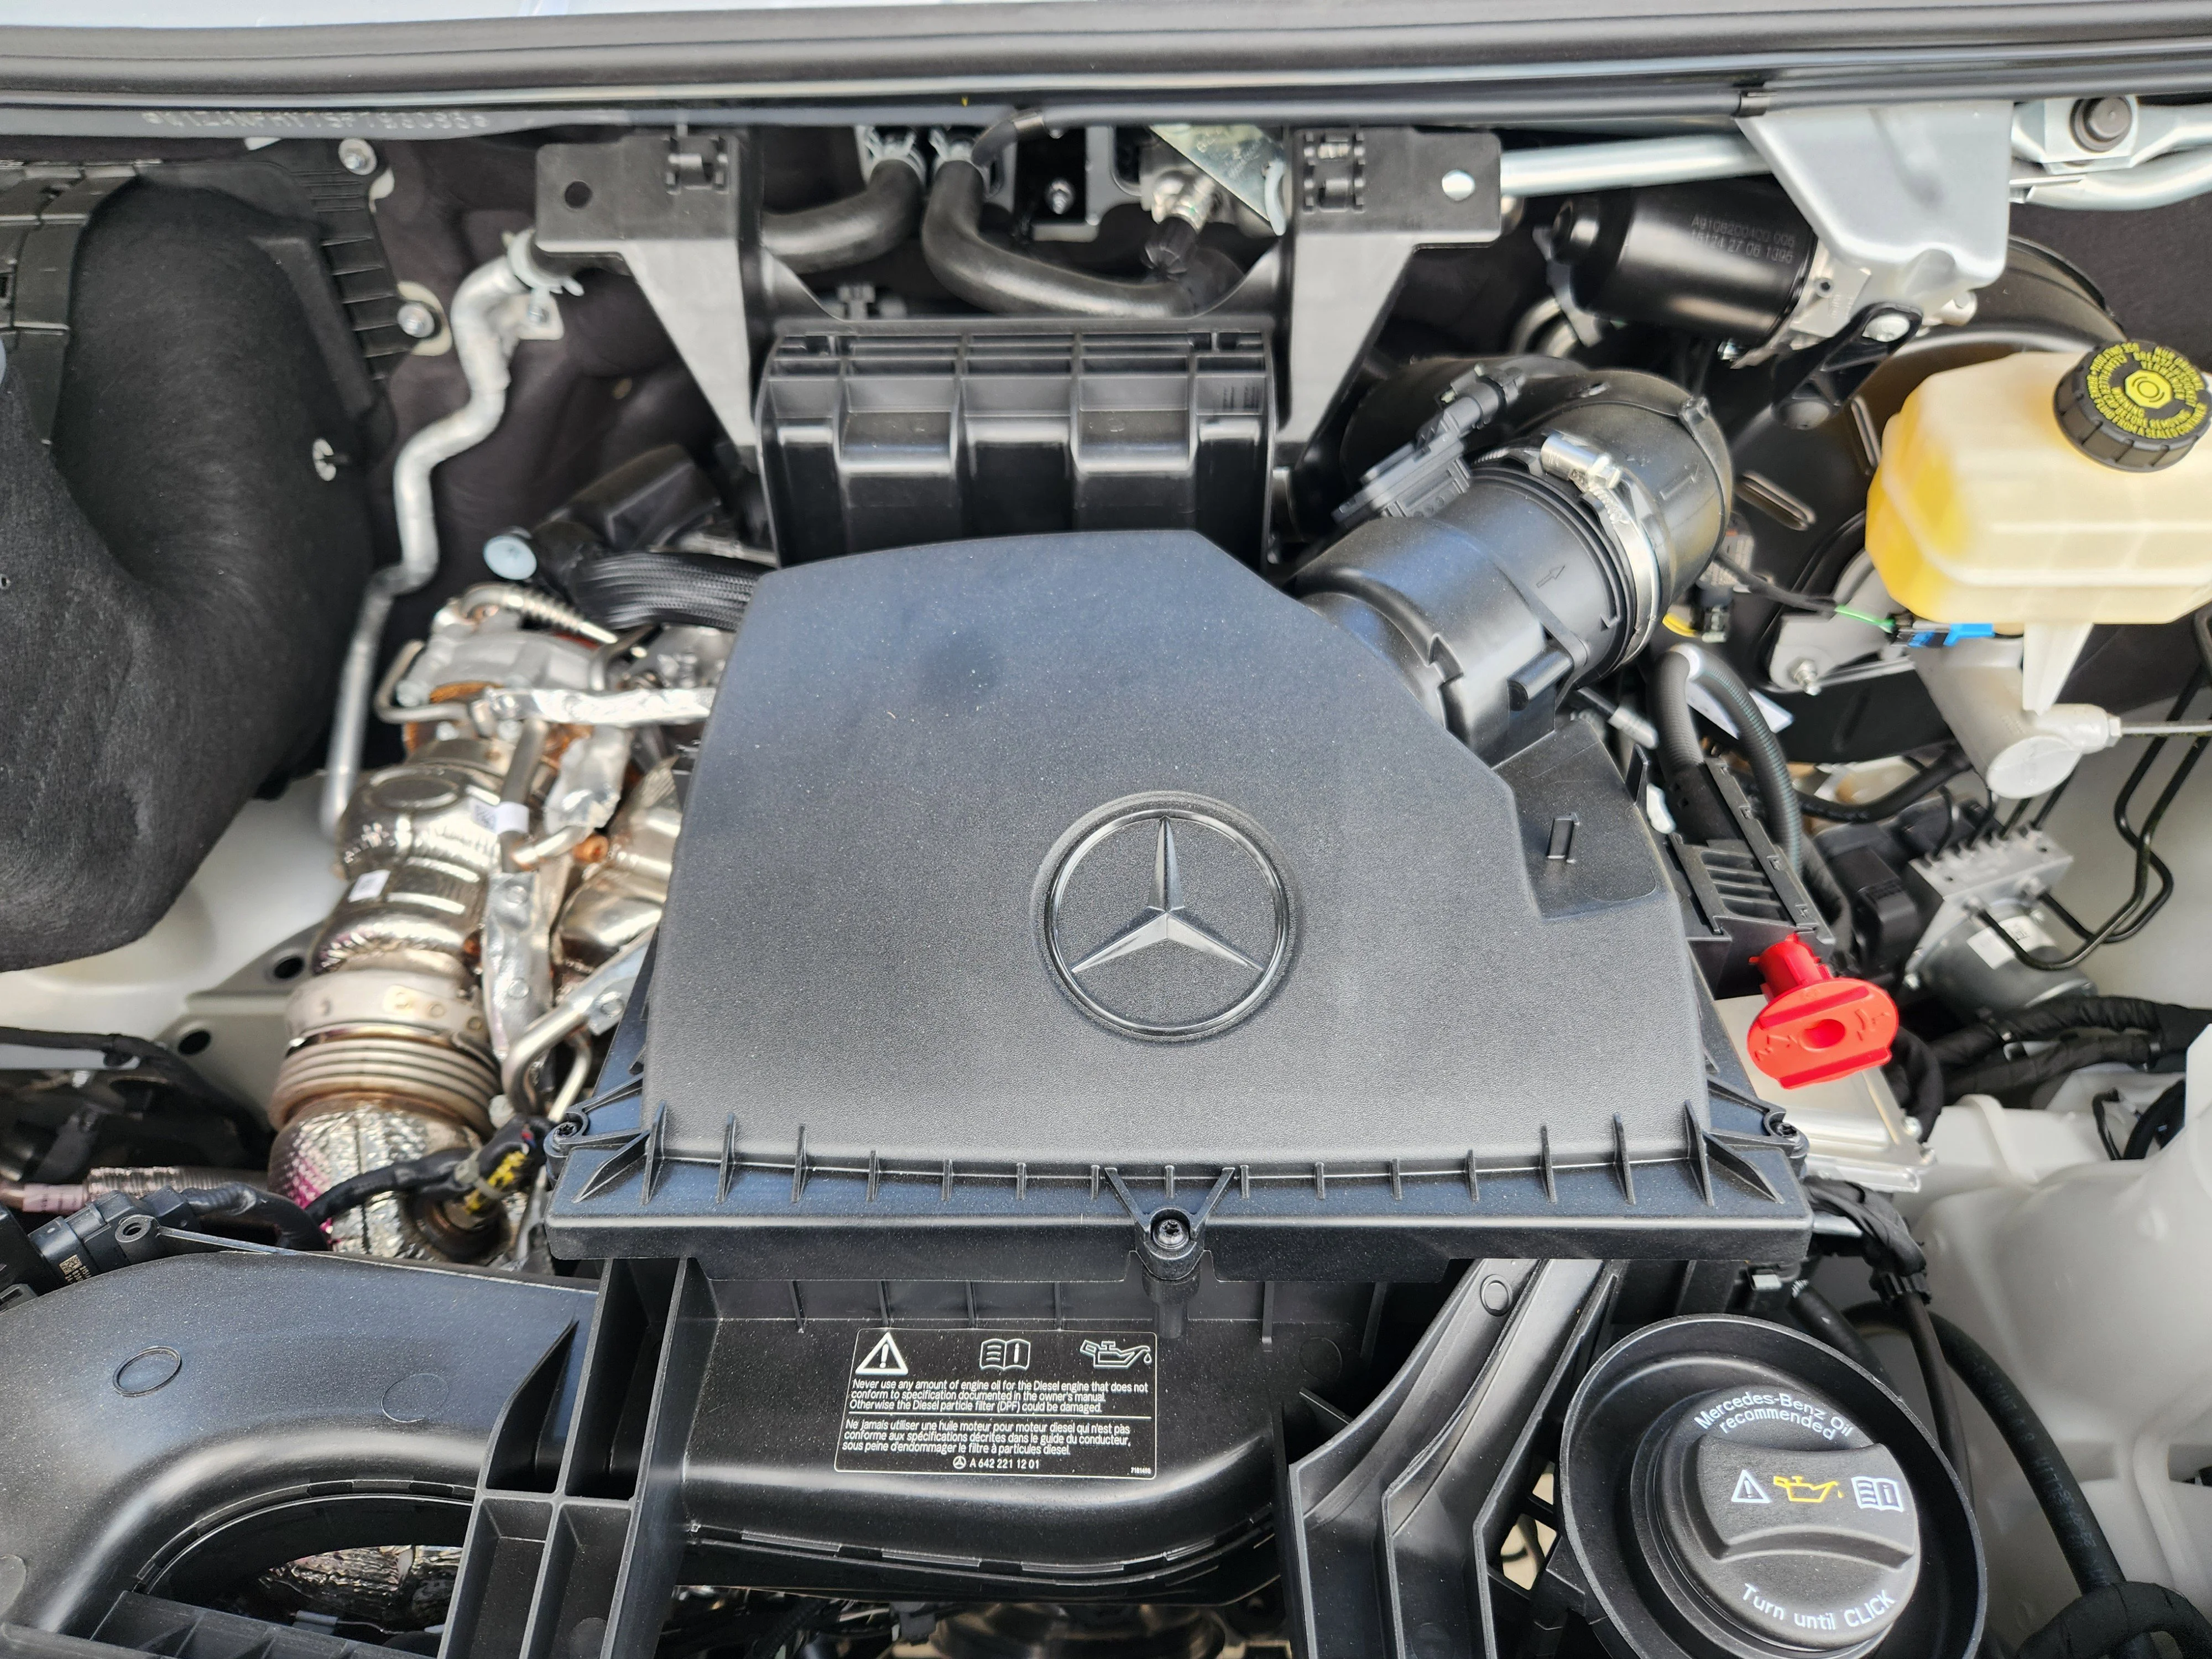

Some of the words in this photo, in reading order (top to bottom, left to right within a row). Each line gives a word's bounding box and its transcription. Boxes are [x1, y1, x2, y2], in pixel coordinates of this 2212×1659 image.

[2086, 374, 2101, 399] BRAKE
[2094, 398, 2116, 420] FLUID
[2111, 415, 2138, 434] FROM
[2137, 426, 2145, 436] A
[2145, 427, 2179, 439] SEALED
[2176, 402, 2208, 435] CONTAINER
[2111, 387, 2145, 418] WARNING
[2115, 406, 2147, 428] BEFORE
[2149, 409, 2192, 429] REMOVING
[852, 1379, 879, 1390] Never
[880, 1381, 896, 1389] use
[898, 1381, 913, 1391] any
[915, 1380, 948, 1390] amount
[949, 1380, 959, 1390] of
[961, 1381, 989, 1391] engine
[991, 1380, 1001, 1390] oil
[1003, 1381, 1015, 1391] for
[1018, 1380, 1031, 1391] the
[1033, 1380, 1060, 1391] Diesel
[1061, 1381, 1089, 1393] engine
[1092, 1381, 1108, 1392] that
[1110, 1381, 1131, 1392] does
[1134, 1382, 1148, 1392] not
[851, 1390, 888, 1400] conform
[890, 1390, 900, 1400] to
[901, 1390, 956, 1402] specification
[958, 1390, 1013, 1401] documented
[1014, 1391, 1021, 1401] in
[1023, 1391, 1037, 1401] the
[1039, 1391, 1073, 1401] owner's
[1074, 1392, 1105, 1402] manual.
[849, 1399, 894, 1410] Otherwise
[897, 1400, 911, 1410] the
[912, 1400, 939, 1410] Diesel
[940, 1400, 973, 1412] particle
[975, 1401, 995, 1411] filter
[997, 1401, 1020, 1413] (DPF)
[1022, 1402, 1045, 1411] could
[1046, 1402, 1058, 1411] be
[1060, 1402, 1102, 1414] damaged.
[1694, 1391, 1827, 1430] Mercedes-Benz
[1830, 1416, 1853, 1437] Oil
[846, 1419, 858, 1430] Ne
[860, 1420, 889, 1431] jamais
[890, 1420, 919, 1430] utiliser
[921, 1421, 937, 1430] une
[938, 1420, 958, 1431] huile
[959, 1422, 991, 1431] moteur
[993, 1423, 1013, 1433] pour
[1016, 1422, 1047, 1432] moteur
[1050, 1422, 1075, 1433] diesel
[1077, 1423, 1089, 1435] qui
[1091, 1423, 1112, 1433] n'est
[1114, 1425, 1130, 1436] pas
[1719, 1408, 1836, 1440] recommended
[844, 1430, 887, 1440] conforme
[888, 1432, 905, 1441] aux
[906, 1430, 968, 1443] spécifications
[969, 1431, 1006, 1442] décrites
[1008, 1433, 1029, 1443] dans
[1030, 1433, 1039, 1443] le
[1040, 1434, 1065, 1446] guide
[1066, 1434, 1078, 1444] du
[842, 1441, 863, 1451] sous
[865, 1441, 889, 1453] peine
[890, 1442, 957, 1454] d'endommager
[958, 1443, 966, 1453] le
[968, 1443, 989, 1454] filtre
[990, 1444, 997, 1454] à
[998, 1444, 1041, 1455] particules
[1043, 1444, 1071, 1455] diesel.
[969, 1458, 976, 1468] A
[978, 1458, 994, 1468] 642
[997, 1459, 1013, 1469] 221
[1016, 1459, 1027, 1469] 12
[1028, 1459, 1040, 1469] 01
[1743, 1583, 1785, 1620] Turn
[1793, 1612, 1836, 1630] until
[1844, 1589, 1896, 1627] CLICK
